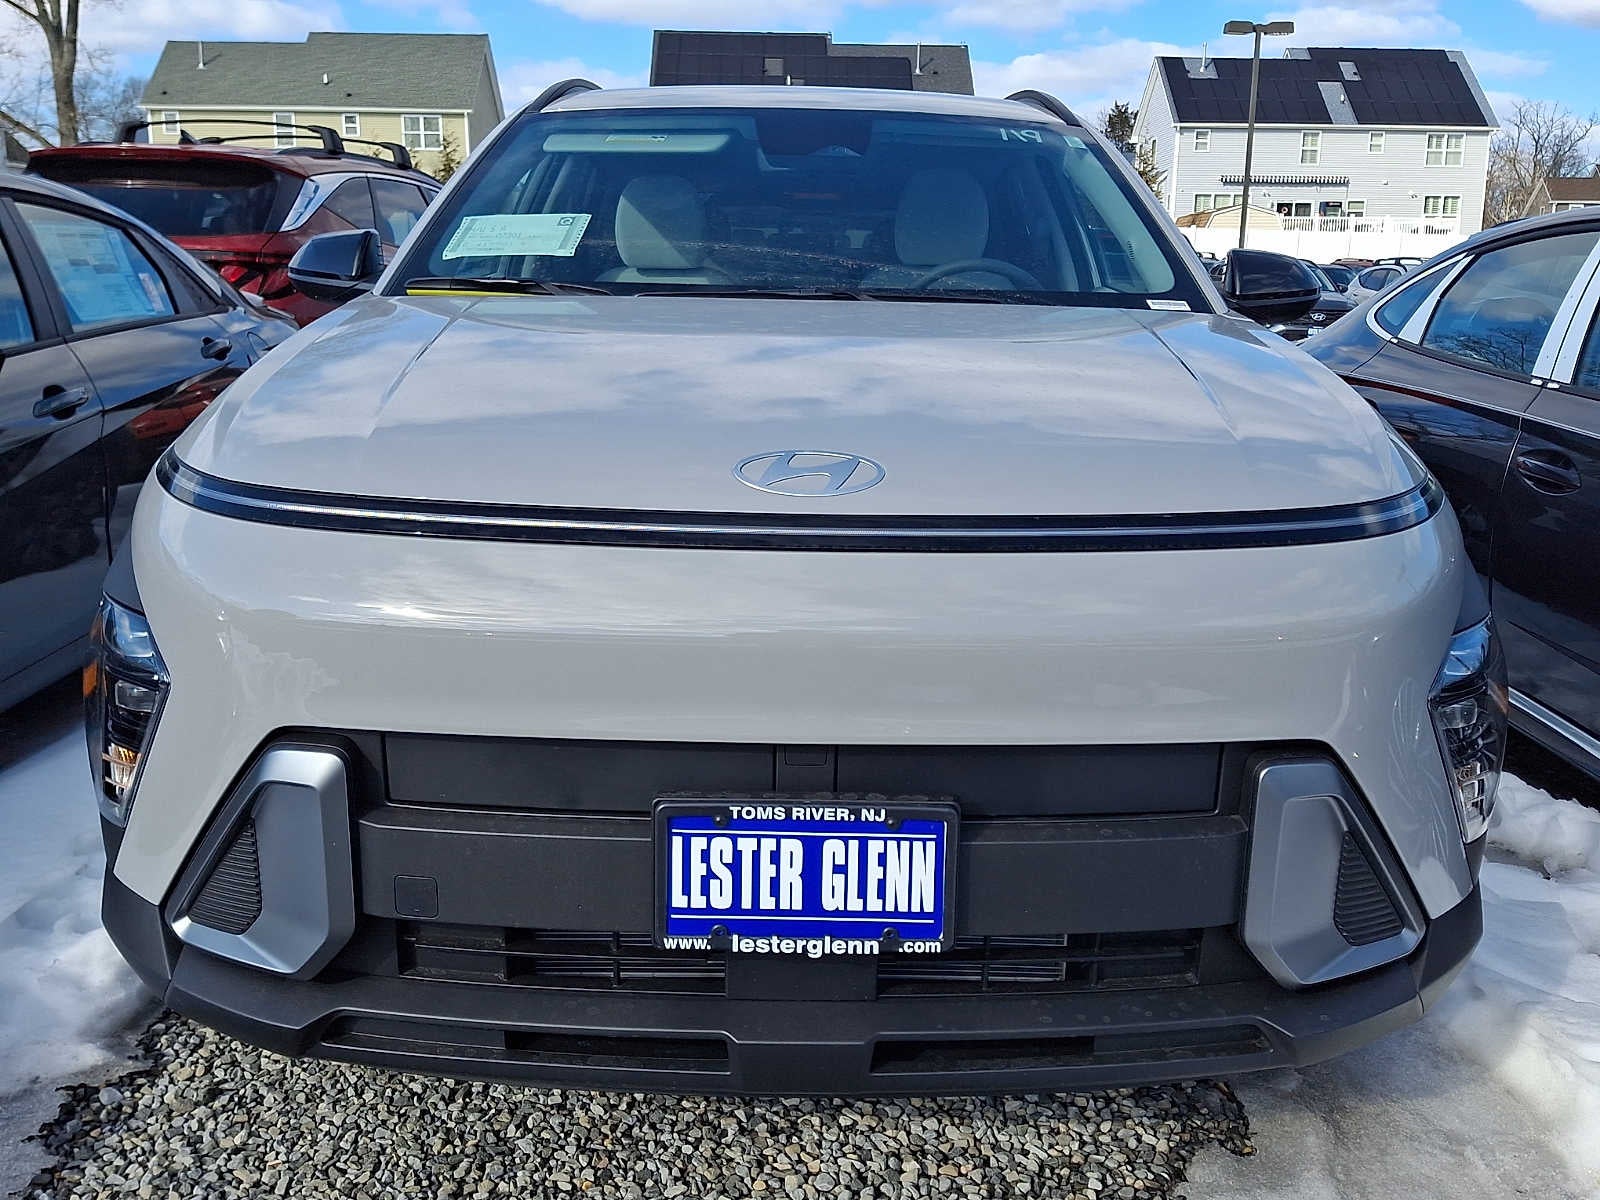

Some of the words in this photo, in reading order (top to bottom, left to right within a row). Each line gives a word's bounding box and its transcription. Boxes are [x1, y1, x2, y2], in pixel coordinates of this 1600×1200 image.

[729, 806, 786, 820] TOMS
[791, 807, 855, 822] RIVER,
[861, 808, 886, 822] NJ
[671, 835, 804, 911] LESTER
[821, 838, 936, 913] GLENN
[663, 937, 711, 950] www.
[732, 934, 880, 959] lesterglenn
[898, 939, 941, 953] .com
